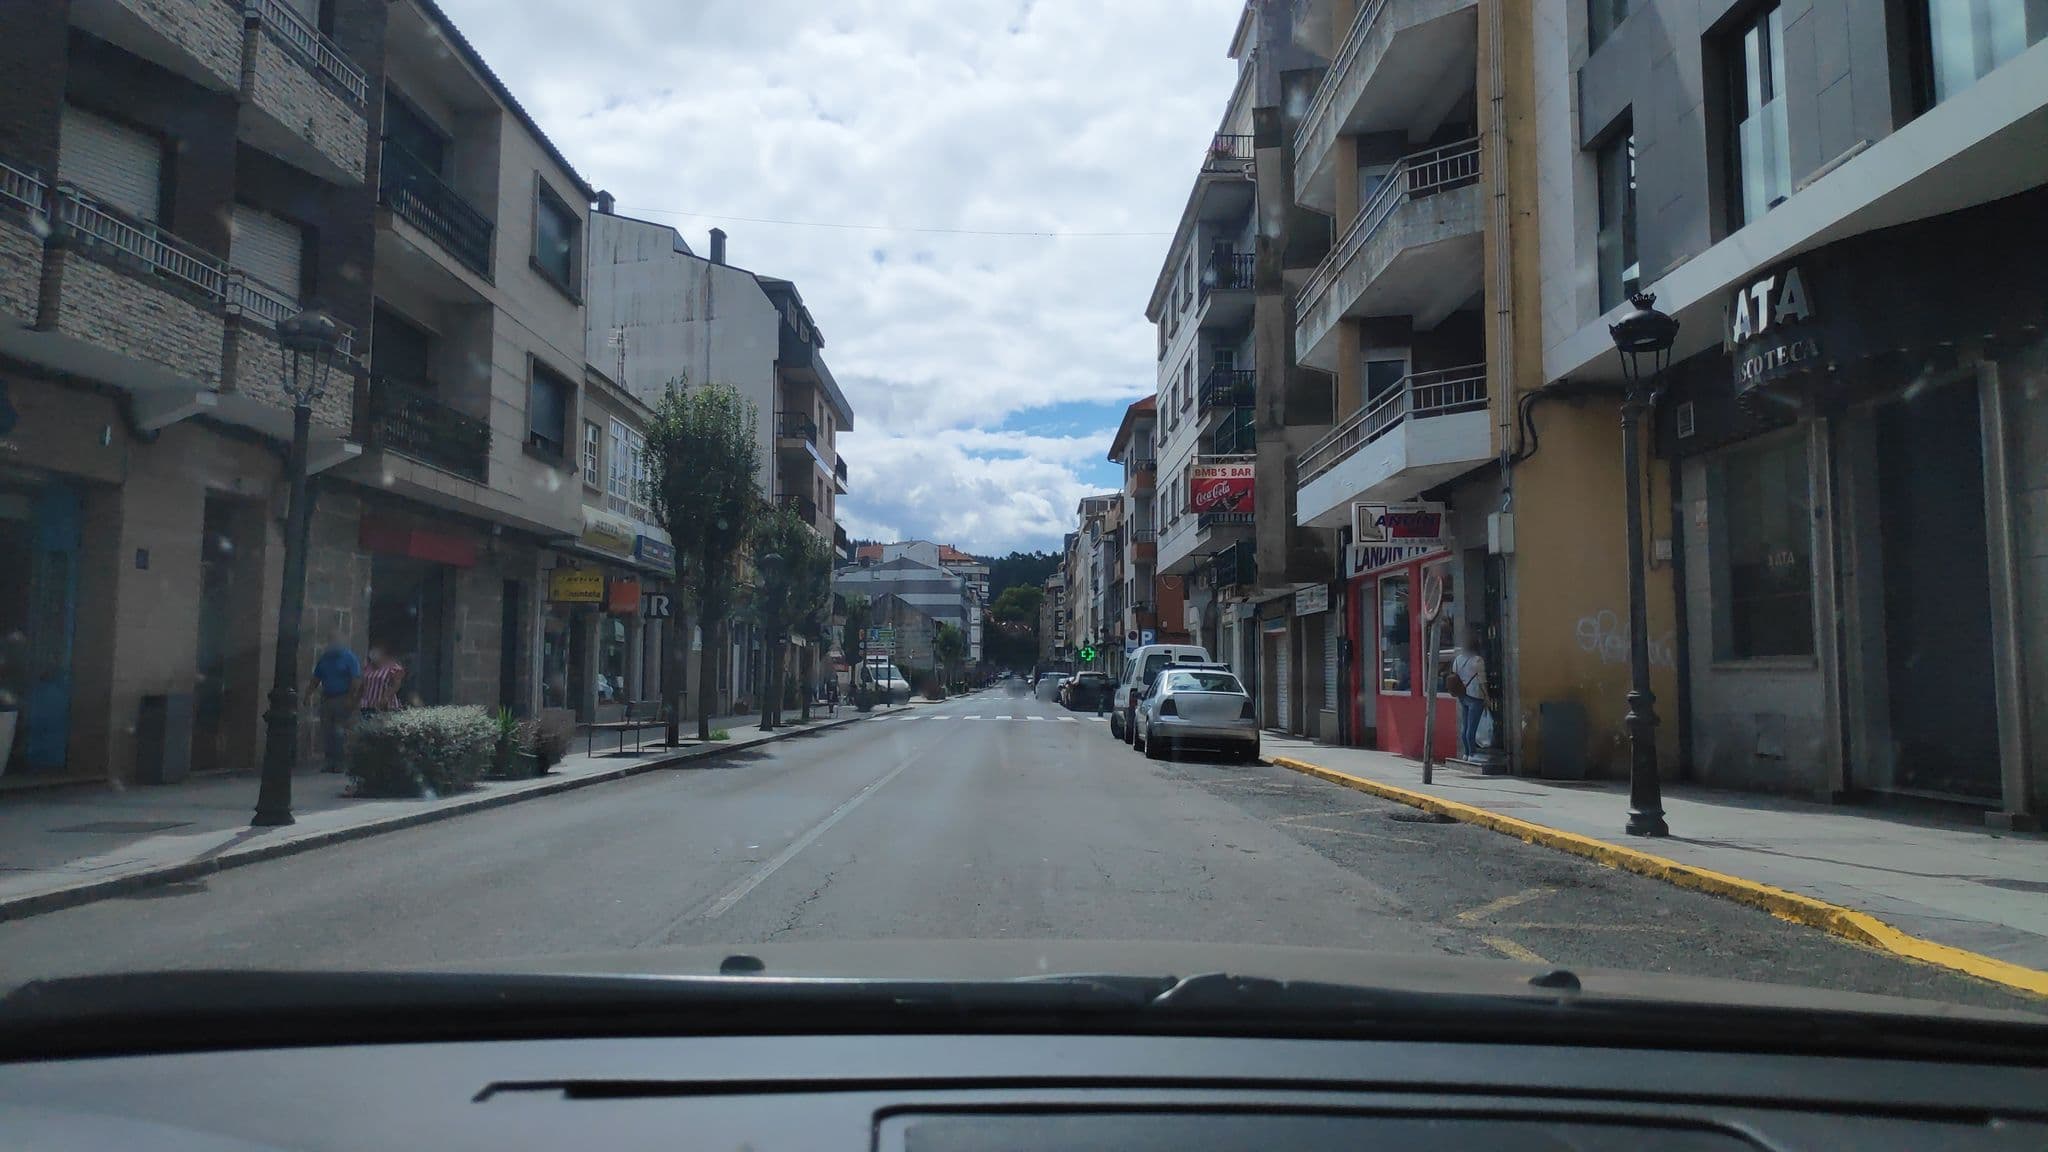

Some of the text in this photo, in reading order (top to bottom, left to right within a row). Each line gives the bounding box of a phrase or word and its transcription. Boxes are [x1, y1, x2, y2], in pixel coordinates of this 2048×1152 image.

[1723, 266, 1809, 356] ATA
[1231, 467, 1252, 477] BAR
[1141, 630, 1153, 646] P
